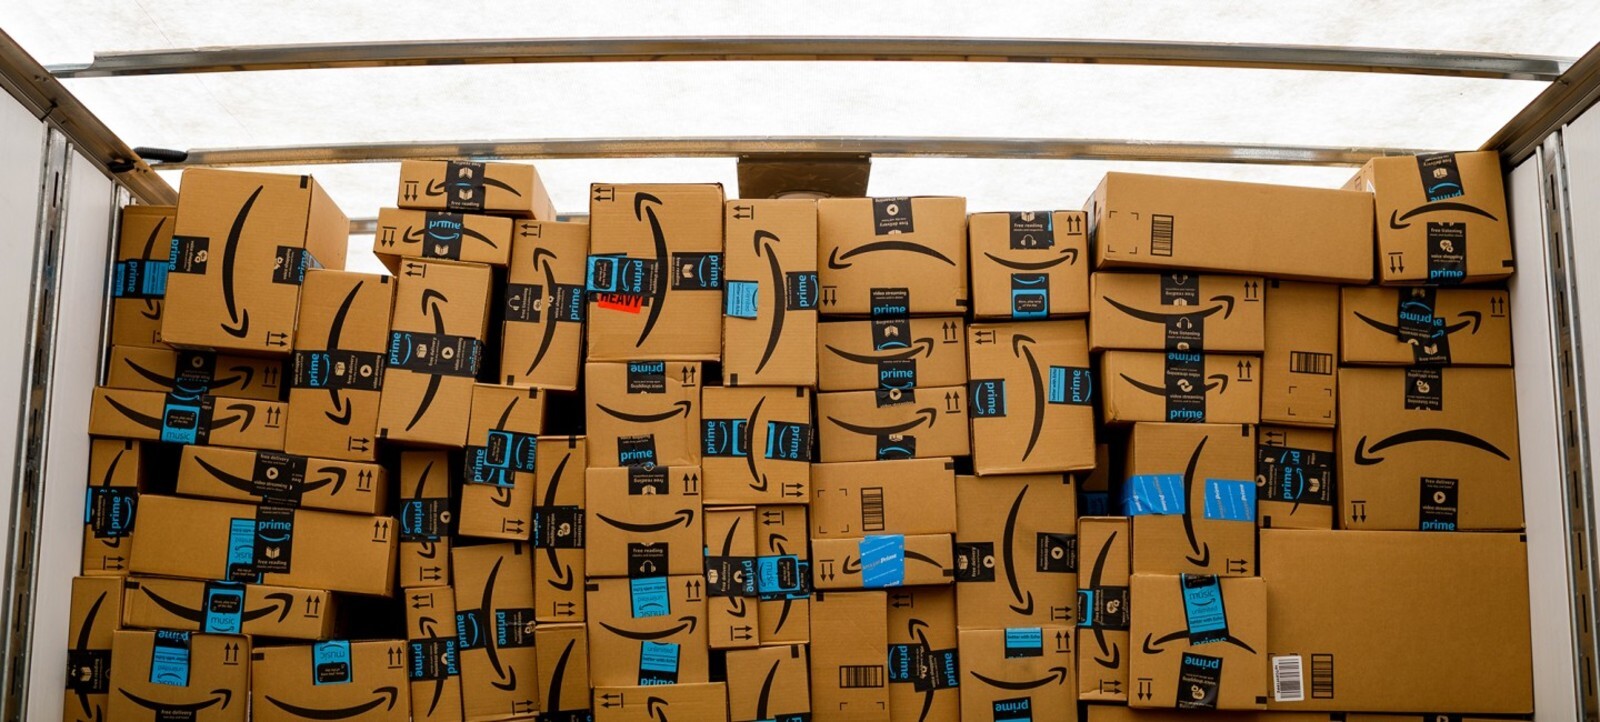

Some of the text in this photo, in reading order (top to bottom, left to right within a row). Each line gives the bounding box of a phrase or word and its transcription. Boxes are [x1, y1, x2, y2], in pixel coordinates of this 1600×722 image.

[169, 238, 181, 271] prime
[128, 261, 139, 292] prime
[633, 259, 645, 293] prime
[708, 254, 720, 288] prime
[569, 288, 581, 320] prime
[599, 292, 642, 308] HEAVY
[797, 274, 809, 307] prime
[873, 304, 906, 315] prime
[1400, 311, 1433, 324] prime
[389, 333, 401, 365] prime
[1168, 352, 1201, 364] prime
[308, 354, 320, 386] prime
[630, 363, 664, 375] prime
[880, 368, 913, 380] prime
[985, 382, 997, 414] prime
[1071, 370, 1081, 402] prime
[1170, 408, 1203, 419] prime
[167, 431, 190, 440] music
[706, 421, 716, 454] prime
[790, 426, 802, 459] prime
[473, 448, 485, 482] prime
[526, 436, 536, 470] prime
[620, 450, 653, 463] prime
[1281, 466, 1294, 500] prime
[110, 496, 121, 529] prime
[258, 519, 291, 530] prime
[413, 501, 425, 534] prime
[1421, 519, 1455, 530] prime
[741, 560, 755, 592] prime
[766, 561, 775, 587] music
[1190, 589, 1214, 600] music
[211, 616, 235, 625] music
[457, 614, 470, 648] prime
[497, 611, 509, 646] prime
[320, 651, 345, 660] music
[412, 643, 425, 677] prime
[446, 640, 458, 674] prime
[898, 645, 910, 679] prime
[944, 652, 958, 686] prime
[1184, 656, 1220, 669] prime
[995, 700, 1029, 712] prime
